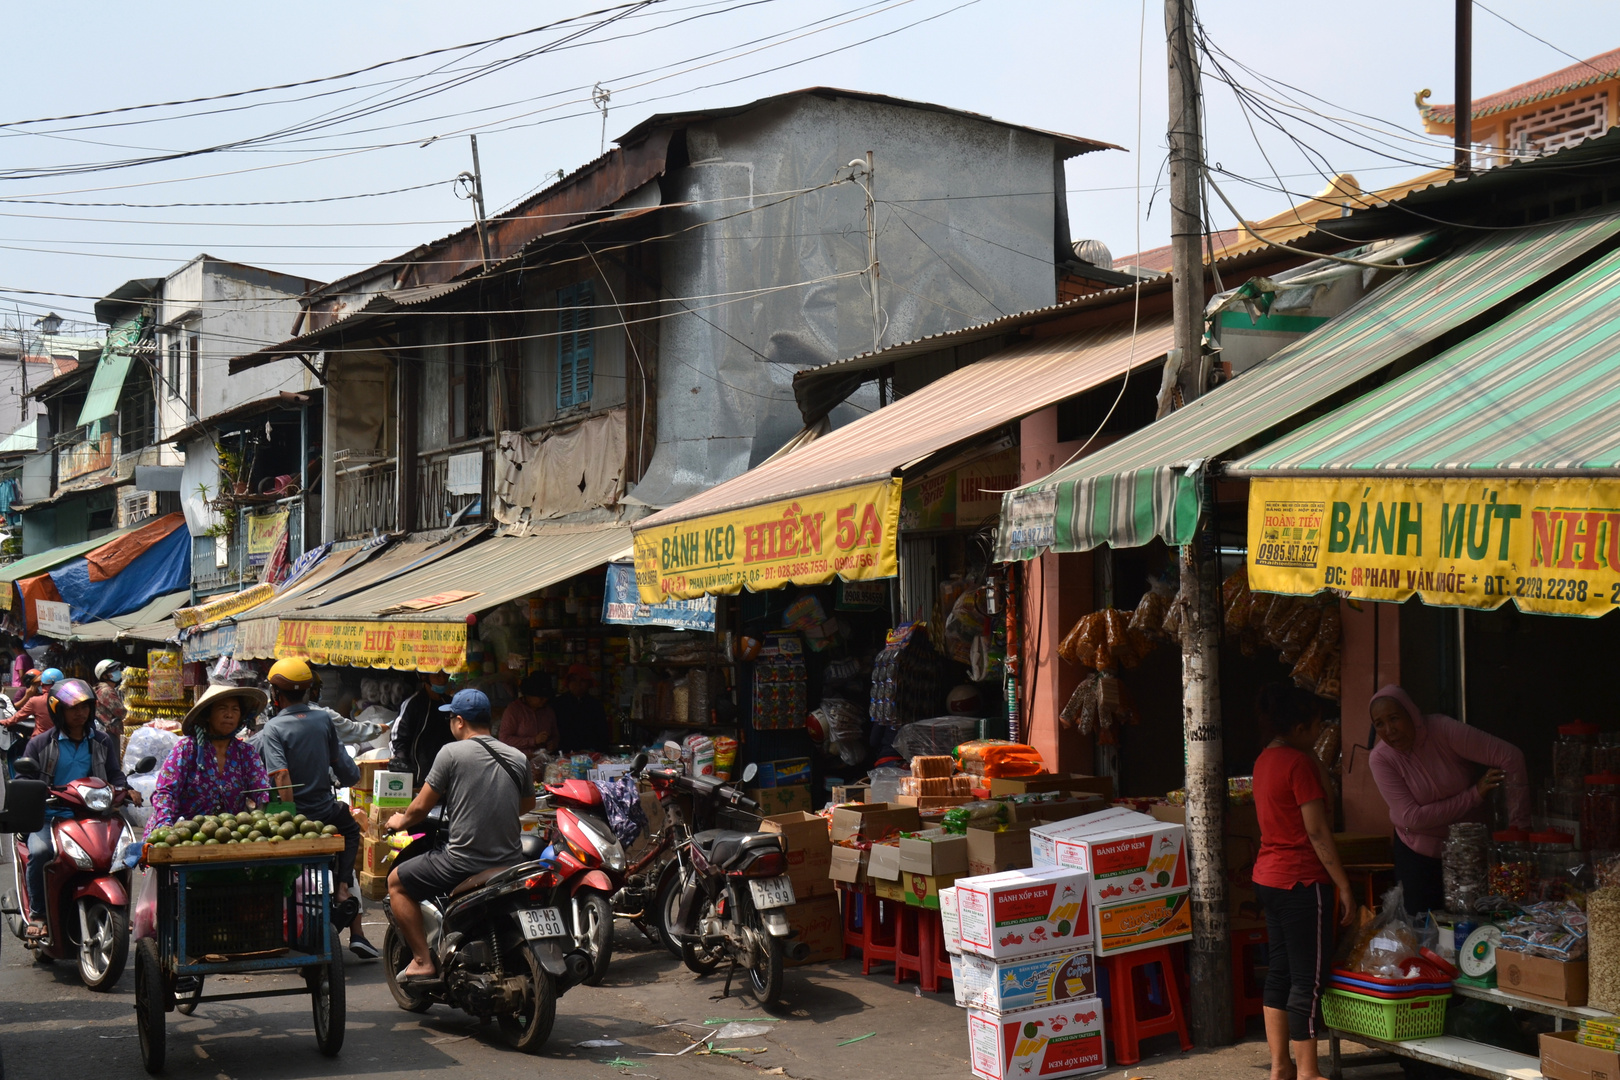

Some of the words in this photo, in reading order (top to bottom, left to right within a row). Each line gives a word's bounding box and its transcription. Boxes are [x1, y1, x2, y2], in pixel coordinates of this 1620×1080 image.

[836, 503, 884, 552] 5A
[1265, 514, 1295, 527] HOÀNG
[1298, 512, 1321, 528] TIẾN
[1328, 487, 1423, 556] BÁNH
[1440, 488, 1522, 561] MỨT
[662, 526, 699, 571] BÁNH
[705, 524, 736, 563] KEO
[1259, 543, 1318, 562] 0985.927.327
[689, 577, 704, 590] PHAN
[765, 566, 776, 580] ĐT:
[777, 560, 828, 579] 028.3856.7550
[1325, 566, 1347, 586] ĐC:
[1365, 568, 1400, 588] PHAN
[1407, 568, 1434, 591] VĂN
[1484, 575, 1511, 596] ĐT:
[1516, 576, 1588, 602] 2229.2238
[364, 624, 396, 652] HUÊ
[1097, 845, 1115, 856] BÁNH
[1117, 842, 1130, 852] XỐP
[1131, 842, 1145, 850] KEM
[760, 891, 789, 906] 7599
[998, 893, 1017, 904] BÁNH
[1018, 890, 1032, 900] XỐP
[1033, 889, 1048, 898] KEM
[526, 910, 557, 923] 30-N3
[530, 922, 561, 937] 6990
[1066, 966, 1091, 978] Coffee
[1048, 1060, 1063, 1069] KEM
[1065, 1057, 1078, 1069] XỐP
[1079, 1054, 1098, 1066] BÁNH
